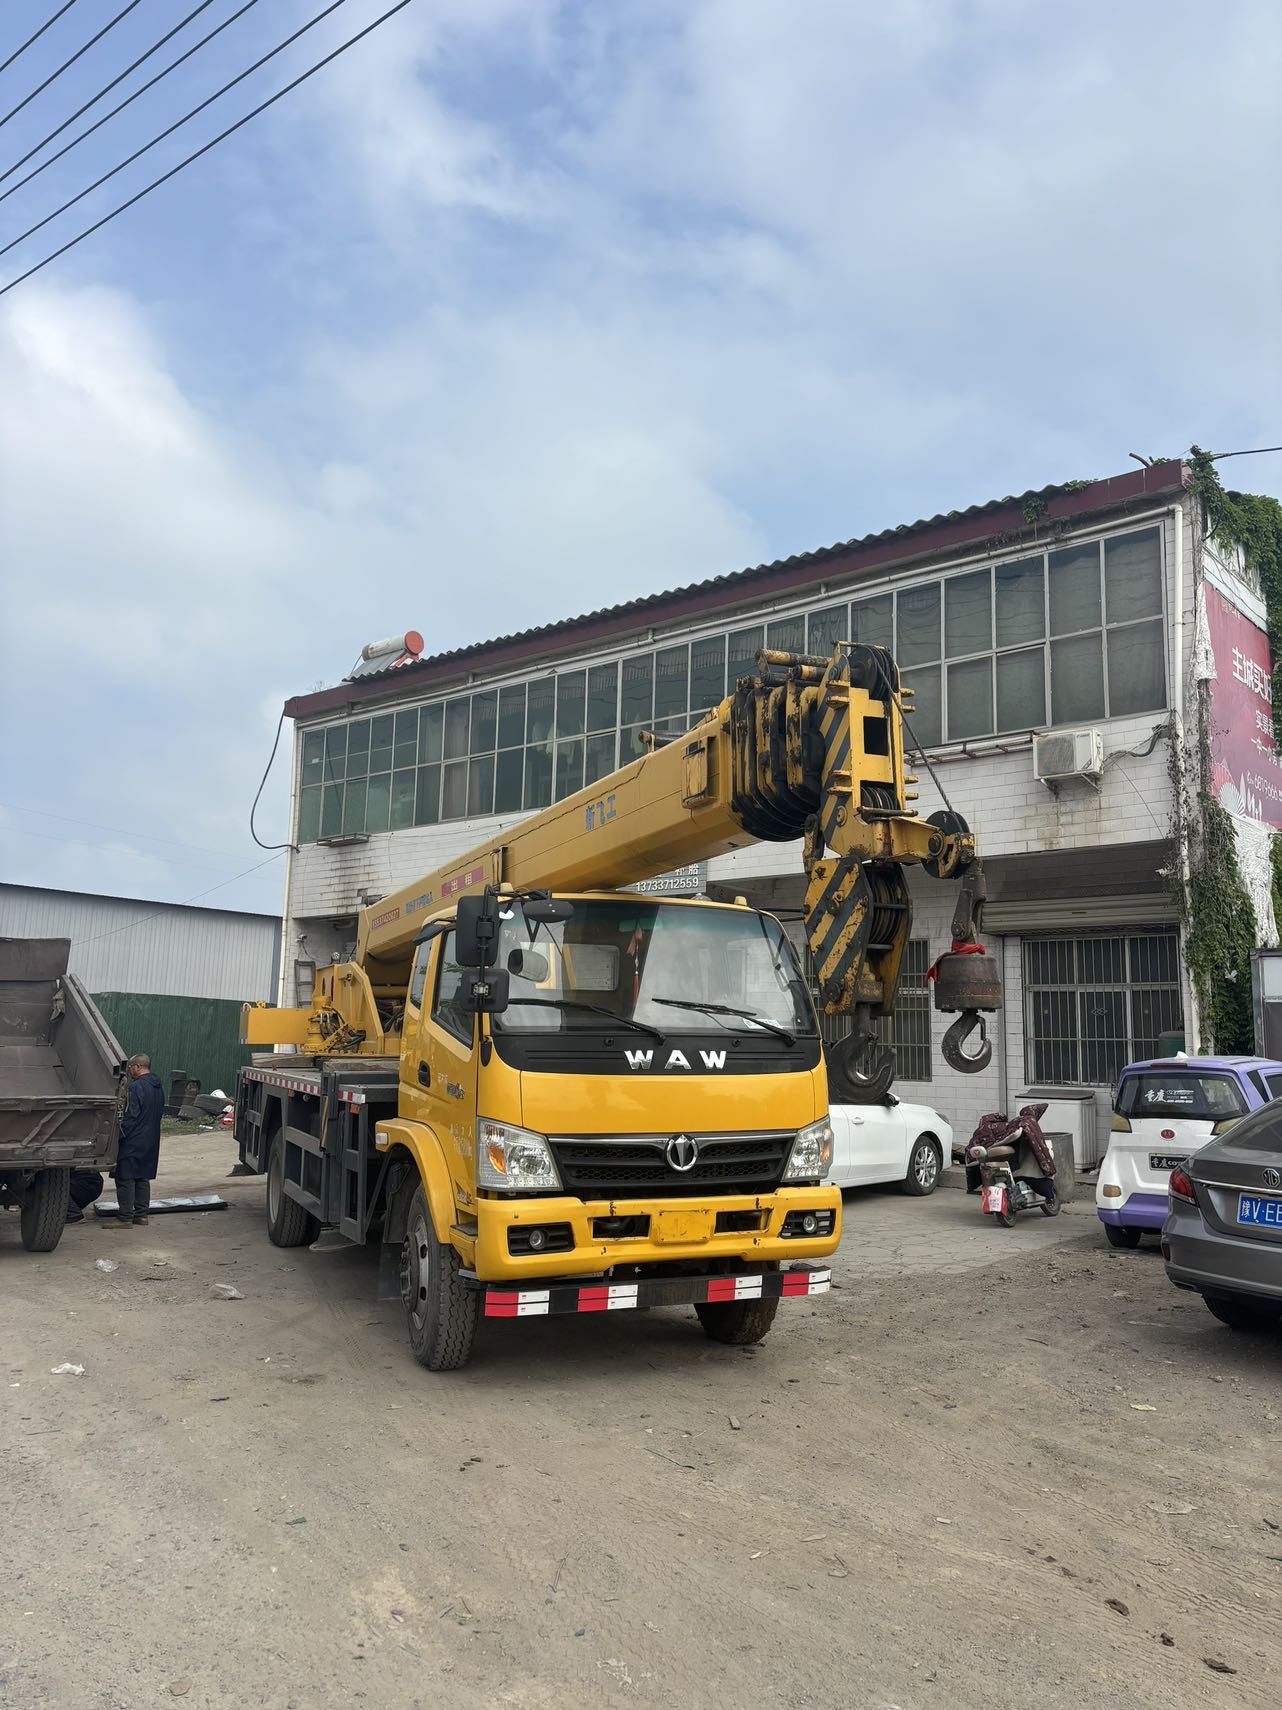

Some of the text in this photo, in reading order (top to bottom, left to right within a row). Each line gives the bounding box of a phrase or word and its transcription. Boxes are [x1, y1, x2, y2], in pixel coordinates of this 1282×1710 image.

[450, 872, 473, 892] 出租
[636, 877, 699, 892] 13733712559
[624, 1050, 727, 1070] WAW
[1263, 1169, 1279, 1187] MG
